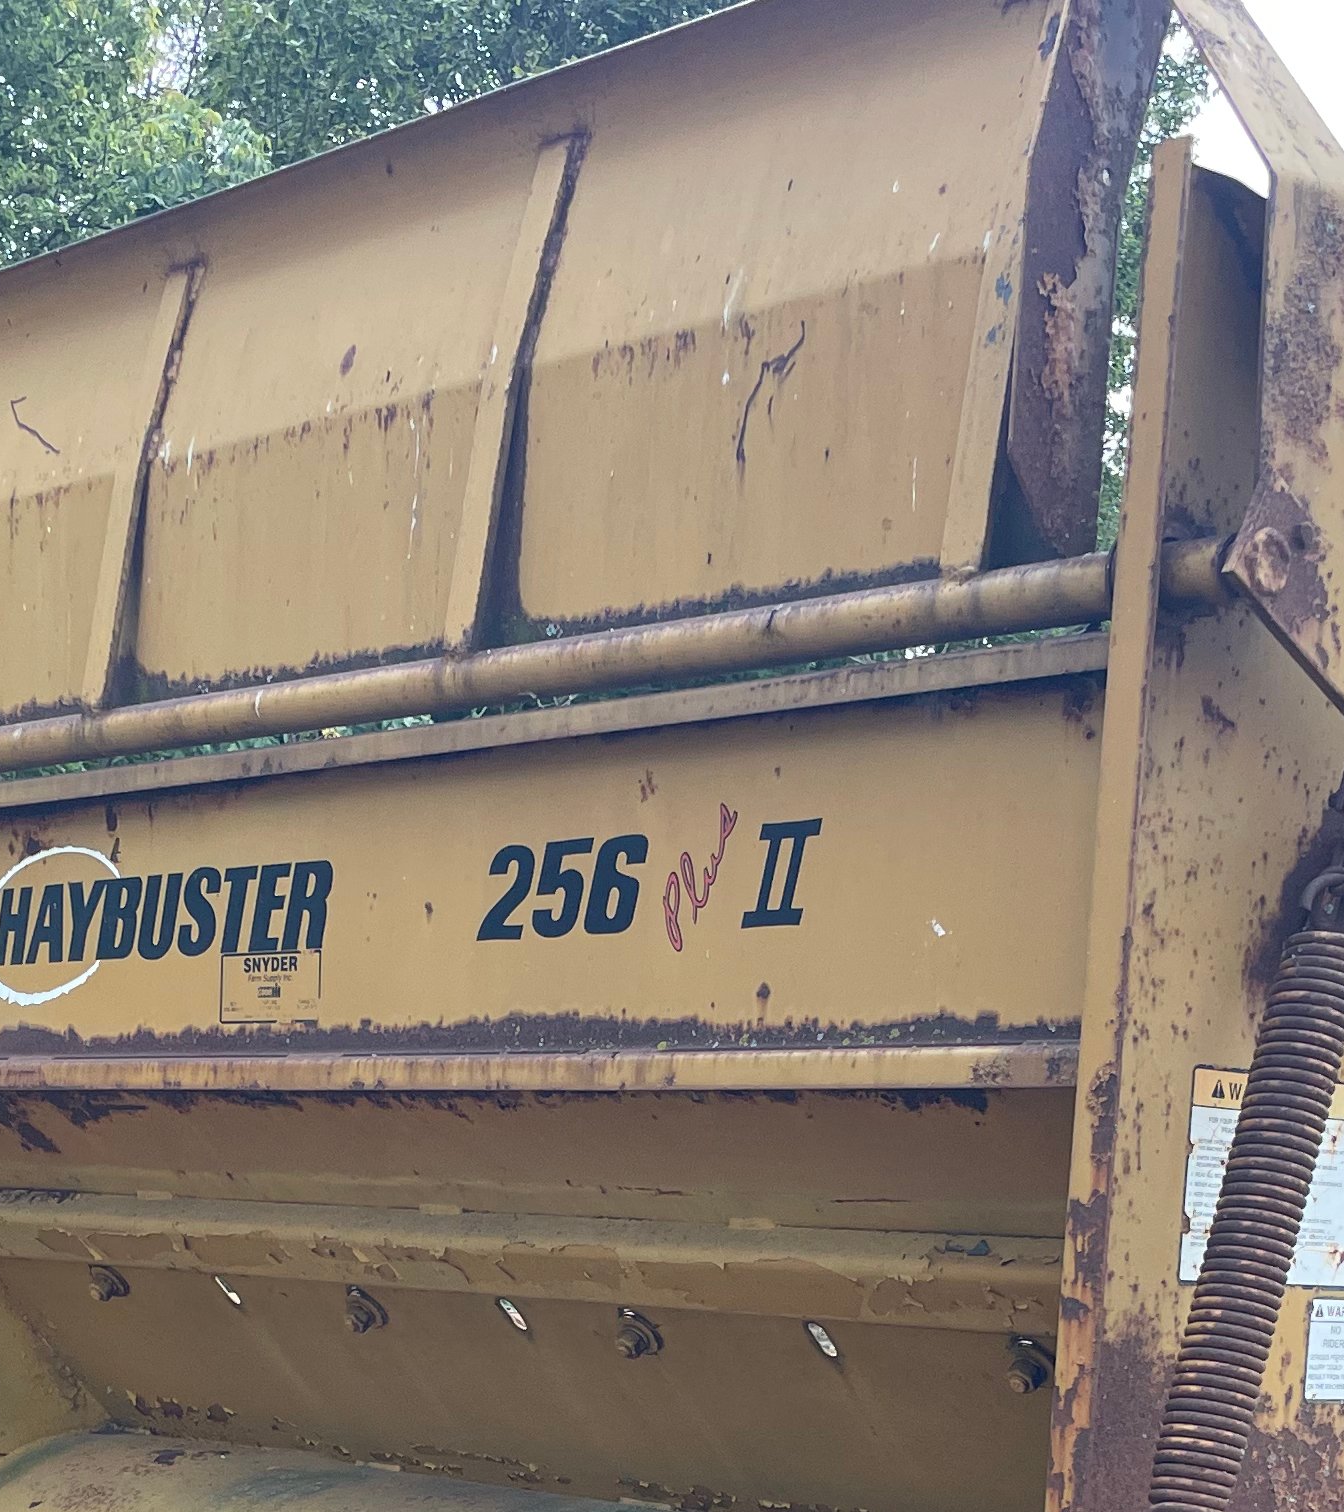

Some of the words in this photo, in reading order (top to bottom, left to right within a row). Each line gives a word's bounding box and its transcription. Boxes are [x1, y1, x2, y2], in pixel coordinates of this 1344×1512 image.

[476, 833, 648, 942] 256
[663, 801, 738, 952] Plus
[741, 817, 823, 928] II
[243, 955, 298, 973] SNYDER
[1330, 1325, 1342, 1335] NO
